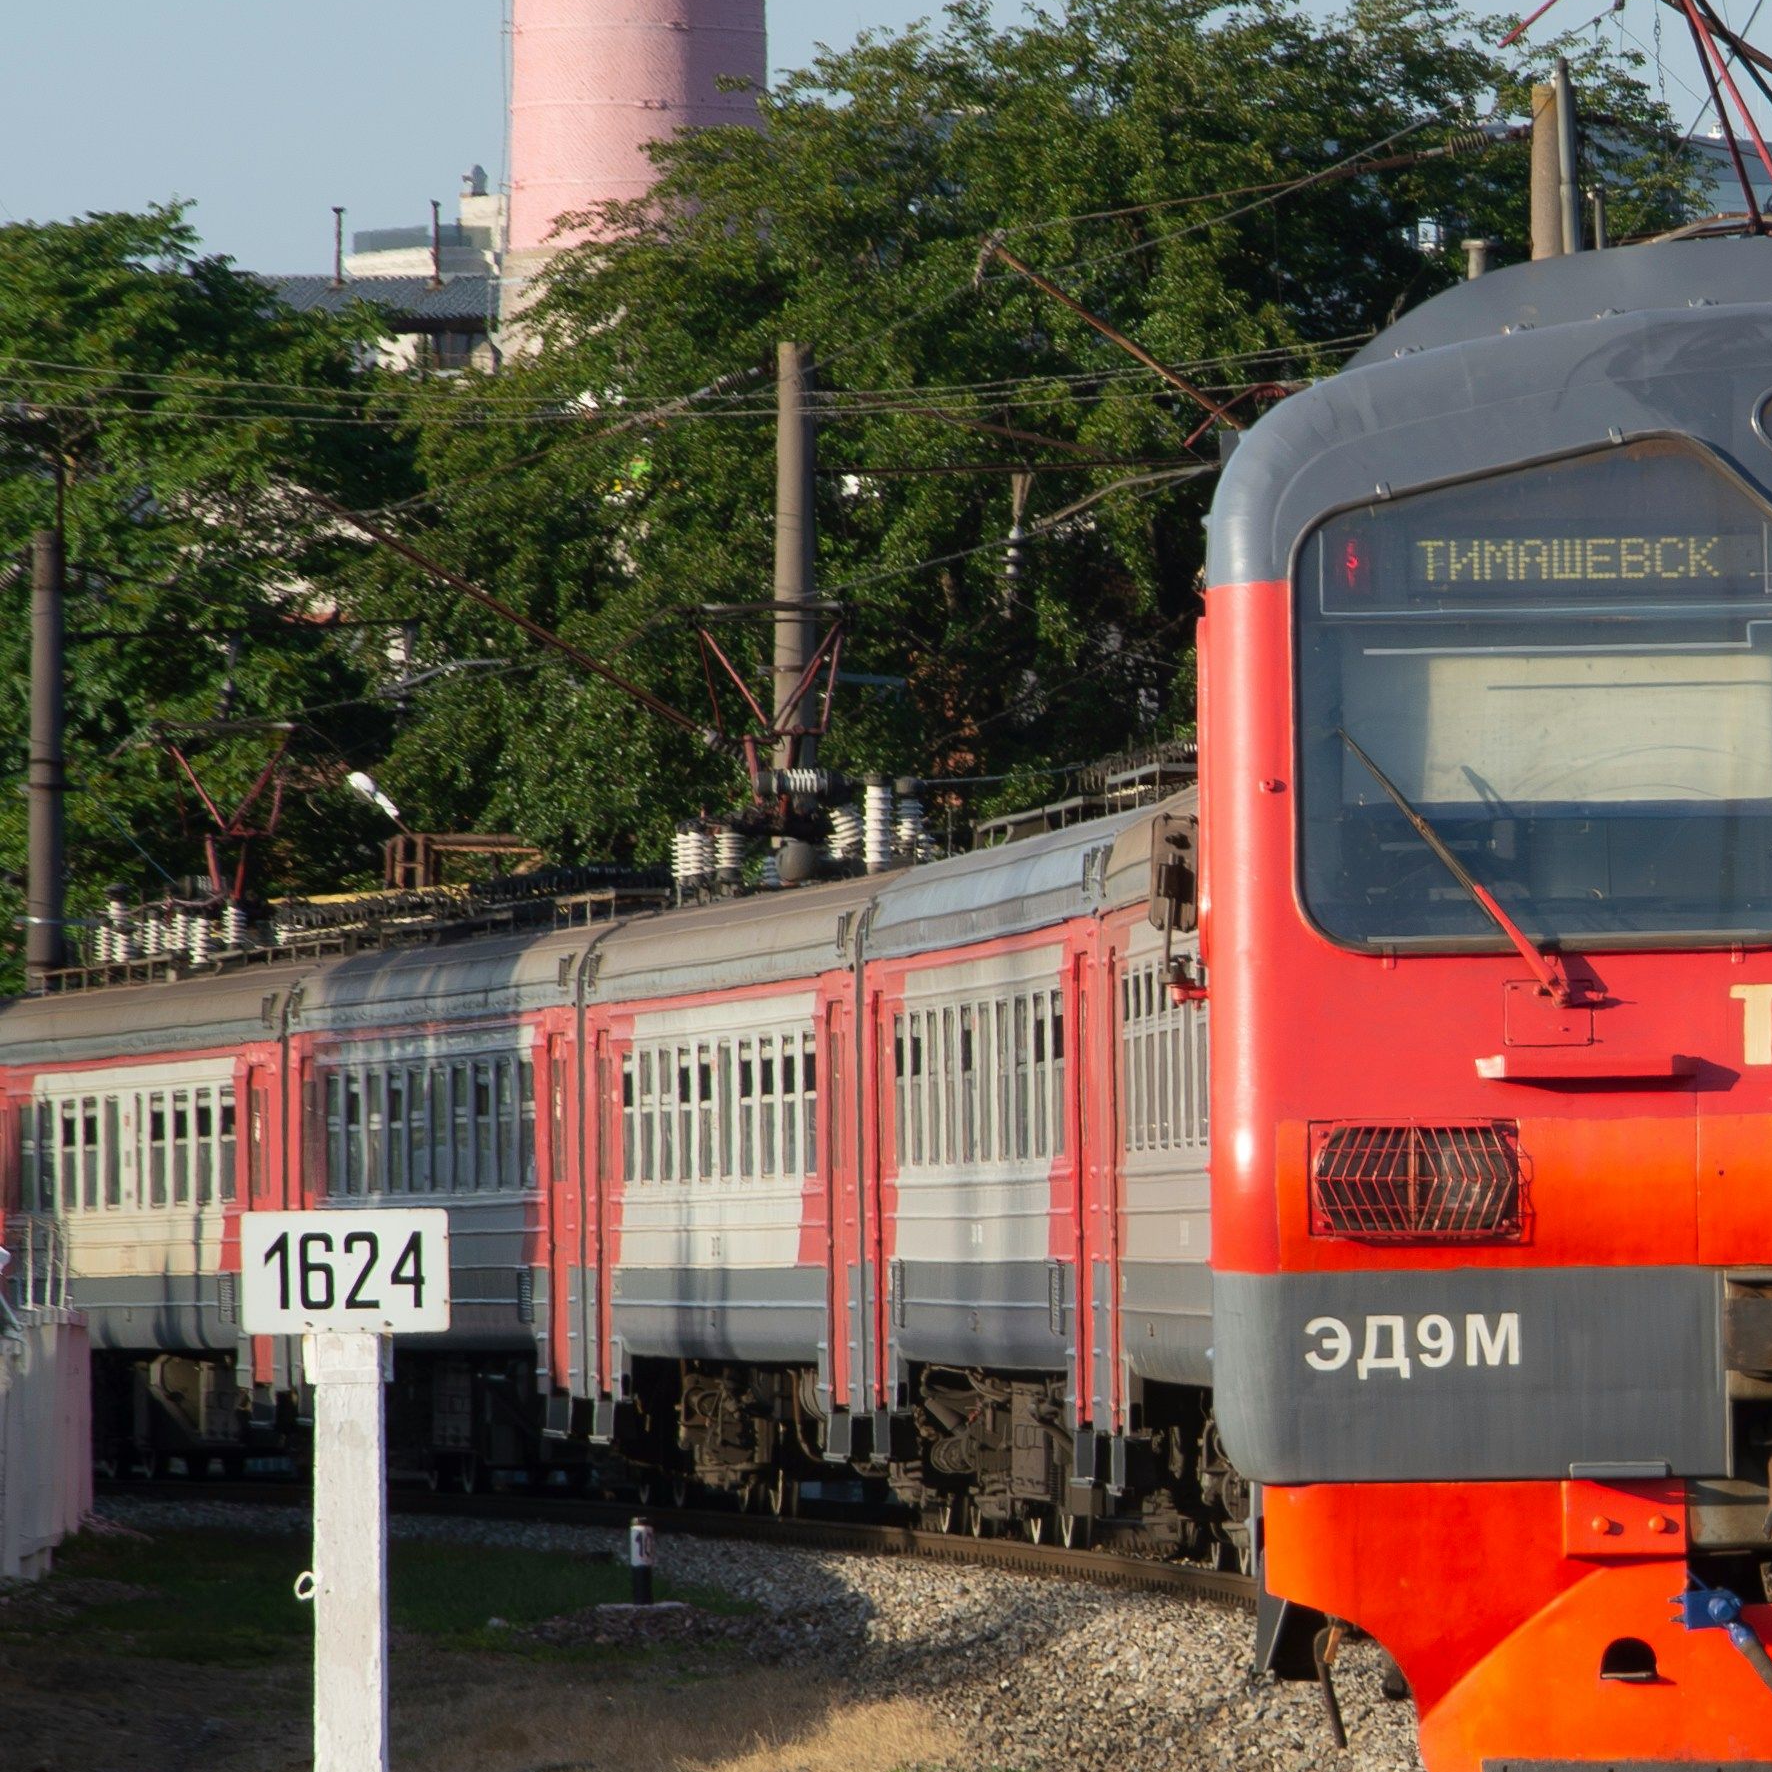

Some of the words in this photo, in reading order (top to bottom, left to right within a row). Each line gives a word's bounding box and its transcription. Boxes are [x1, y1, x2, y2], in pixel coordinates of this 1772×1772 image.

[1416, 536, 1721, 581] ТИМАШЕВСК
[264, 1230, 425, 1310] 1624
[1304, 1312, 1521, 1380] ЭД9М
